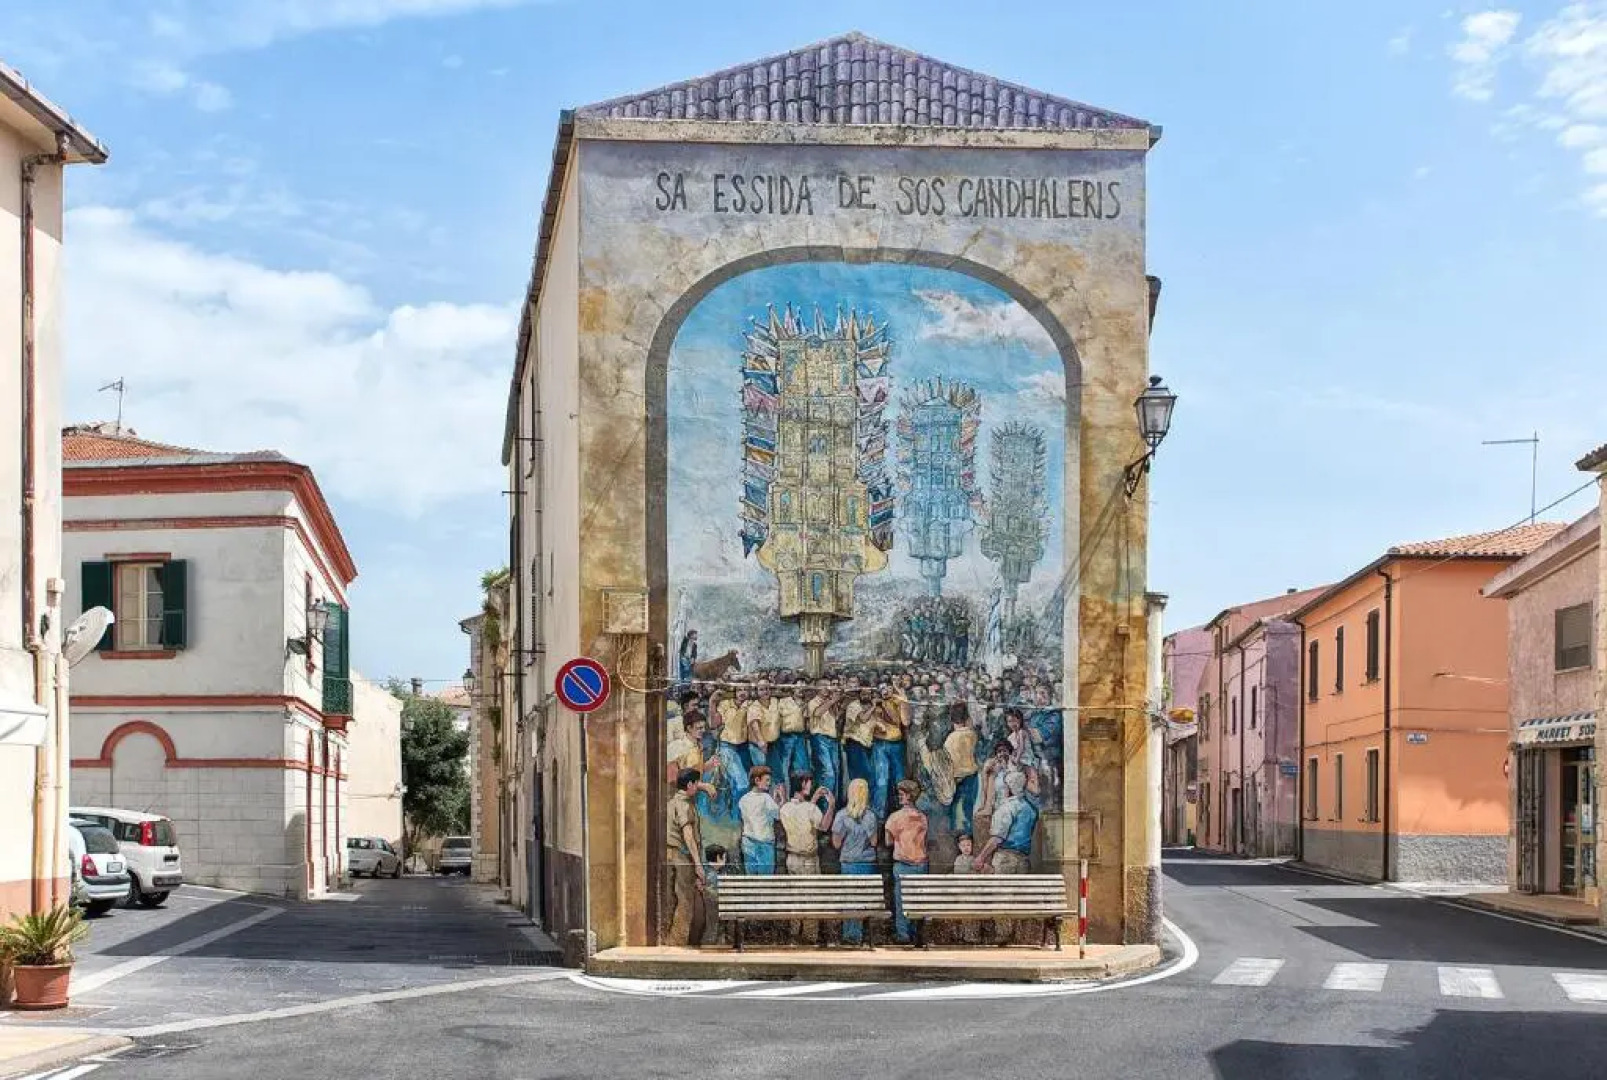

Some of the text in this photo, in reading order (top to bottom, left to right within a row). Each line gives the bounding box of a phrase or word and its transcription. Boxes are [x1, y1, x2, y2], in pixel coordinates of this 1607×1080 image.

[655, 172, 1121, 219] SA ESSIDA DE SOS CANDHALERIS
